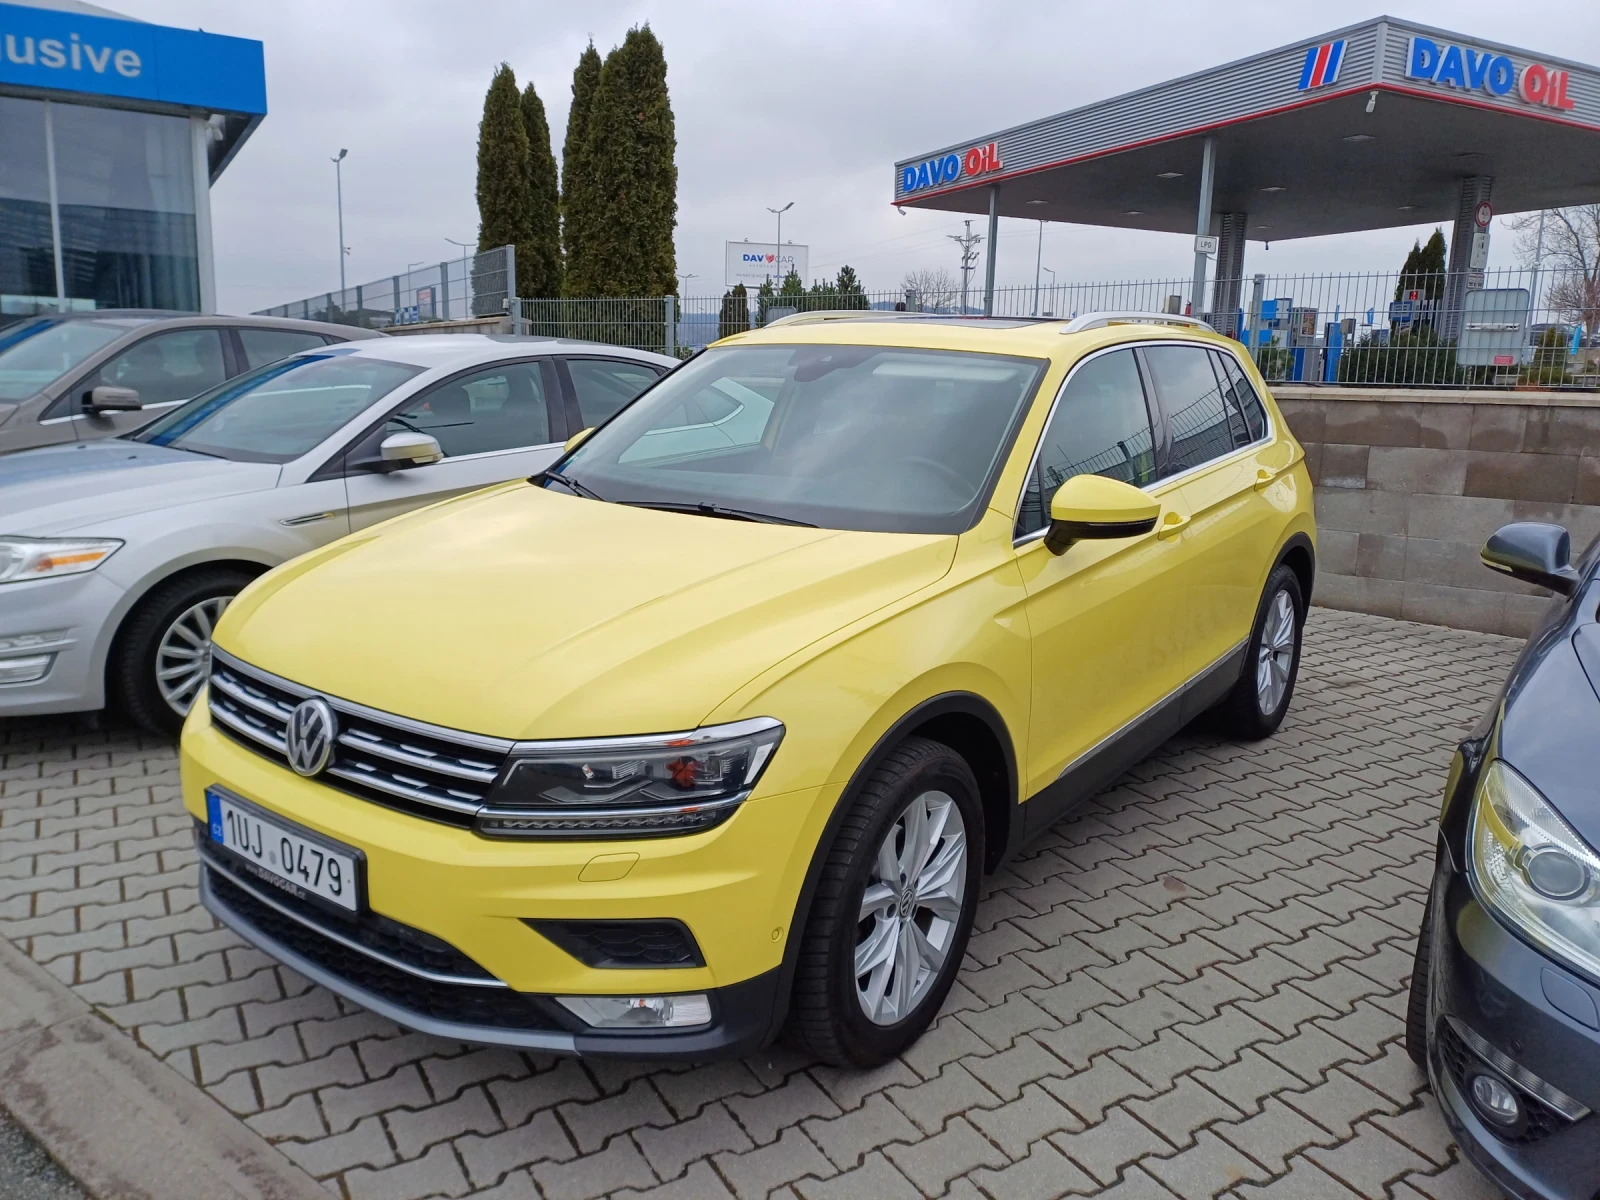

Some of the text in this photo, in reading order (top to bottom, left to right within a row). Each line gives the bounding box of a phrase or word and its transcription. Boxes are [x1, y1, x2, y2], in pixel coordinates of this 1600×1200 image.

[0, 33, 142, 77] usive
[1405, 37, 1514, 96] DAVO
[903, 154, 961, 192] DAVO
[1200, 241, 1212, 249] LPG
[227, 809, 342, 896] 1UJ 0479
